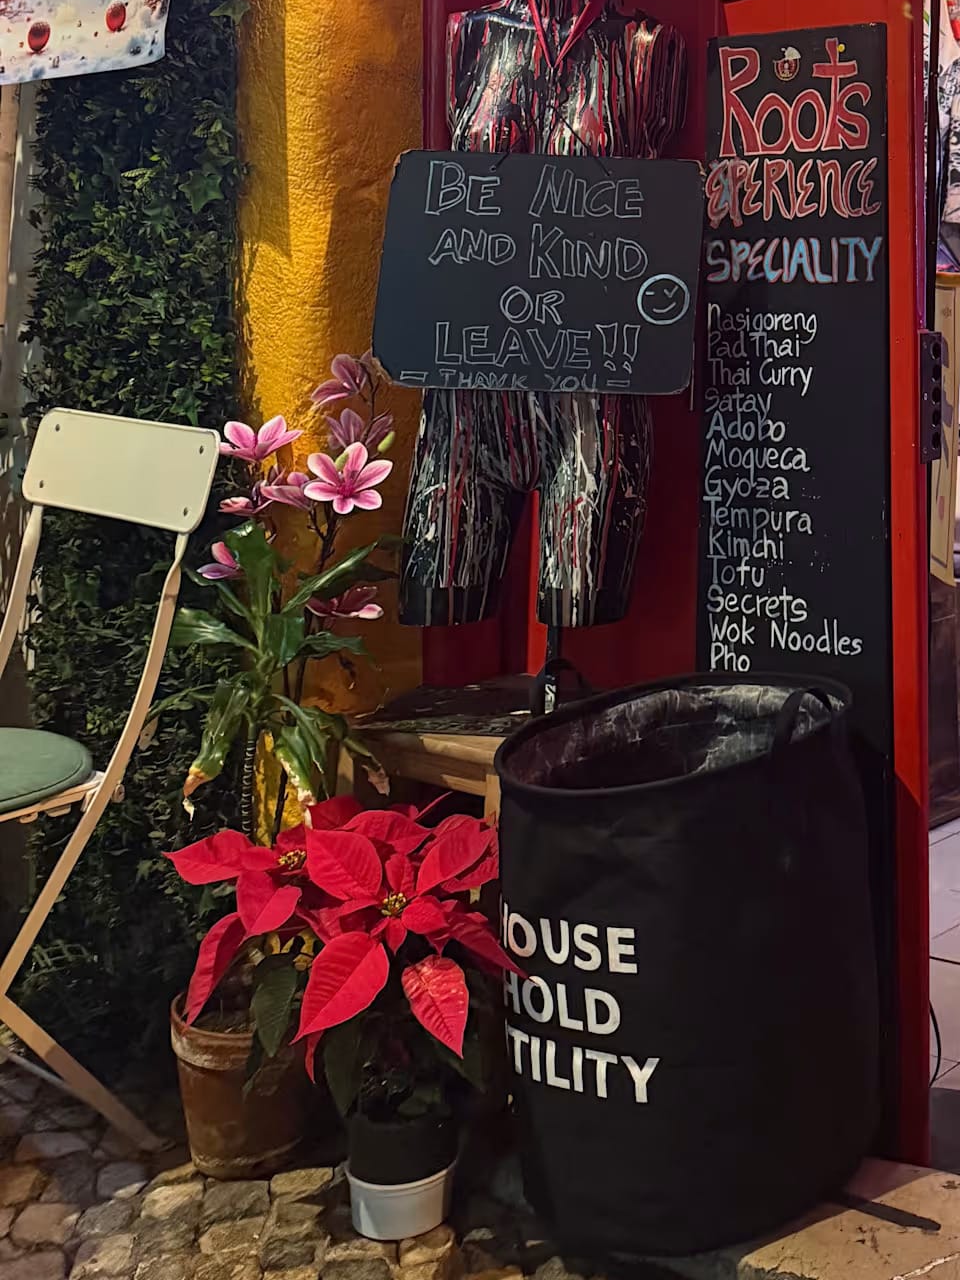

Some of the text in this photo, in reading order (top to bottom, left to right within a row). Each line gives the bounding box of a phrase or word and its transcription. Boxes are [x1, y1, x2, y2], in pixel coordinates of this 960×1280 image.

[719, 37, 871, 157] Roots
[425, 161, 644, 219] BE NICE
[428, 223, 649, 280] AND KIND
[706, 237, 883, 283] SPECIALITY
[500, 286, 565, 325] OR
[707, 331, 801, 361] Pad Thai
[440, 369, 597, 392] THANK YOU
[708, 357, 813, 397] Thai Curry
[704, 387, 773, 420] Satay
[706, 410, 786, 442] Adobo
[705, 439, 810, 477] Moqueca
[704, 466, 790, 507] Gyoza
[703, 495, 812, 542] Tempura
[708, 529, 784, 561] Kimchi
[707, 555, 765, 588] Tofu
[706, 584, 808, 622] Secrets
[709, 614, 862, 656] Wok Noodles
[709, 642, 751, 673] Pho
[504, 1018, 660, 1103] TILITY
